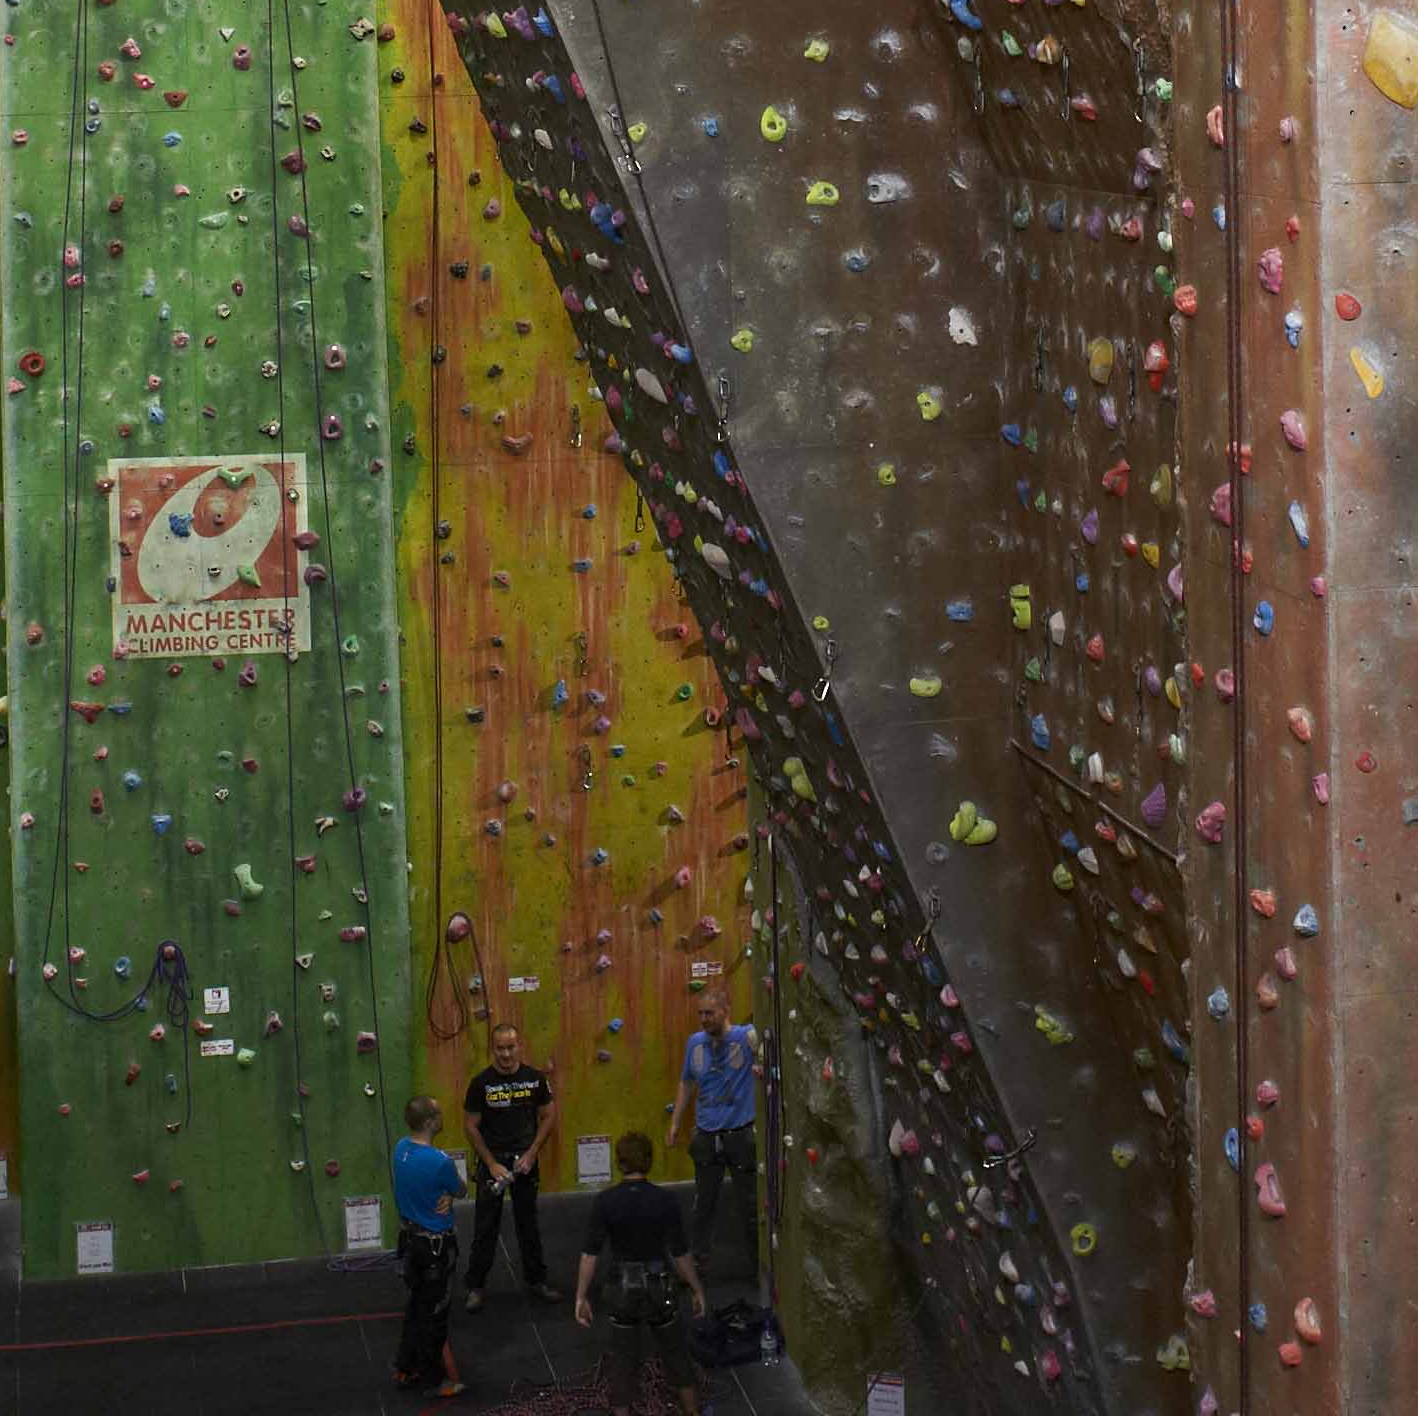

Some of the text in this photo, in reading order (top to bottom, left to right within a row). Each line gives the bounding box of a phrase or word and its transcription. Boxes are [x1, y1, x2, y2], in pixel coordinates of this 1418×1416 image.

[126, 608, 295, 633] MANCHESTER
[128, 632, 296, 653] CLIMBING CENTRE
